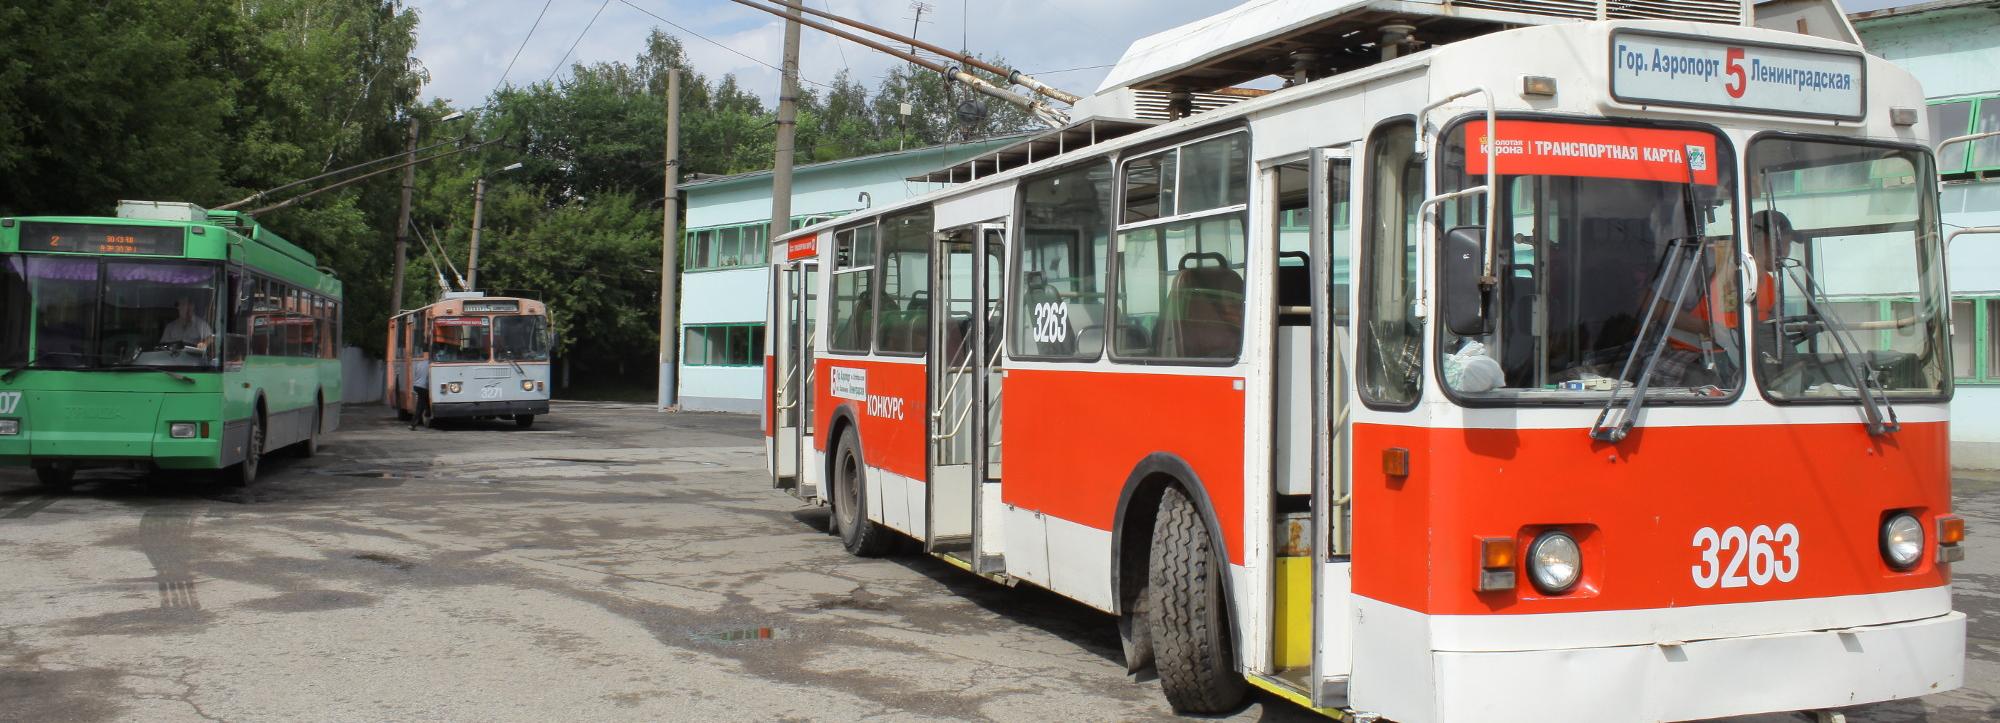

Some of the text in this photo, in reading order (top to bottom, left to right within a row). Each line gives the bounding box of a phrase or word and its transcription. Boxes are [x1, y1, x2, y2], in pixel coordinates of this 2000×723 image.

[1618, 44, 1851, 99] Гор. Аэропорт 5 Ленинградская
[1535, 140, 1683, 164] ТРАНСПОРТНАЯ КАРТА
[50, 235, 61, 247] 2
[1033, 301, 1067, 343] 3263
[481, 387, 503, 399] 3271
[867, 394, 904, 420] КОНКУРС
[1691, 522, 1800, 589] 3263
